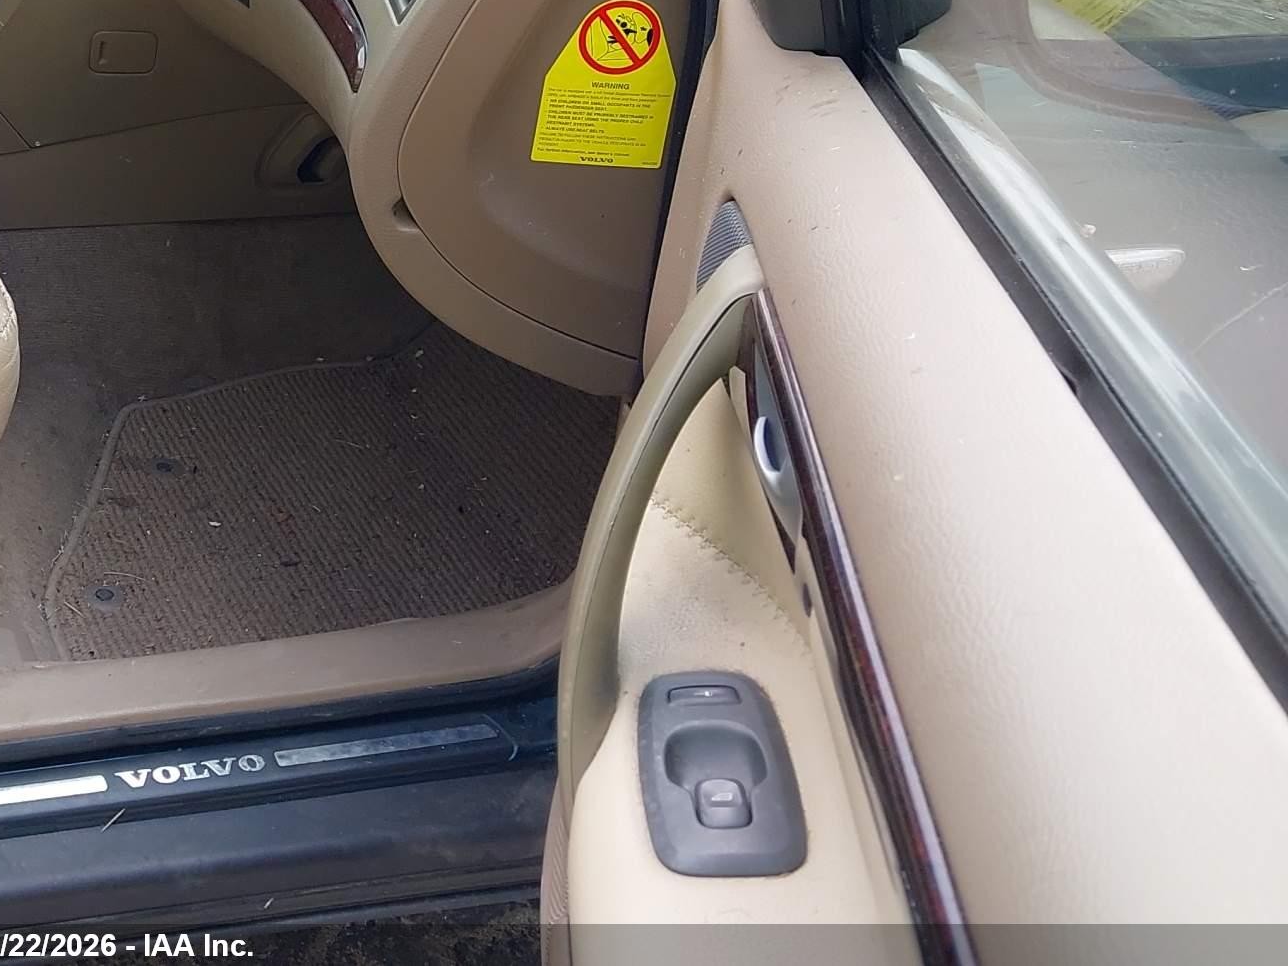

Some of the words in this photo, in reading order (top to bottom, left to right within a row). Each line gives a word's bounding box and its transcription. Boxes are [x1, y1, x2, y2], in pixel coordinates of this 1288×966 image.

[591, 81, 630, 90] WARNING
[580, 156, 614, 164] VOLVO
[114, 755, 265, 788] VOLVO
